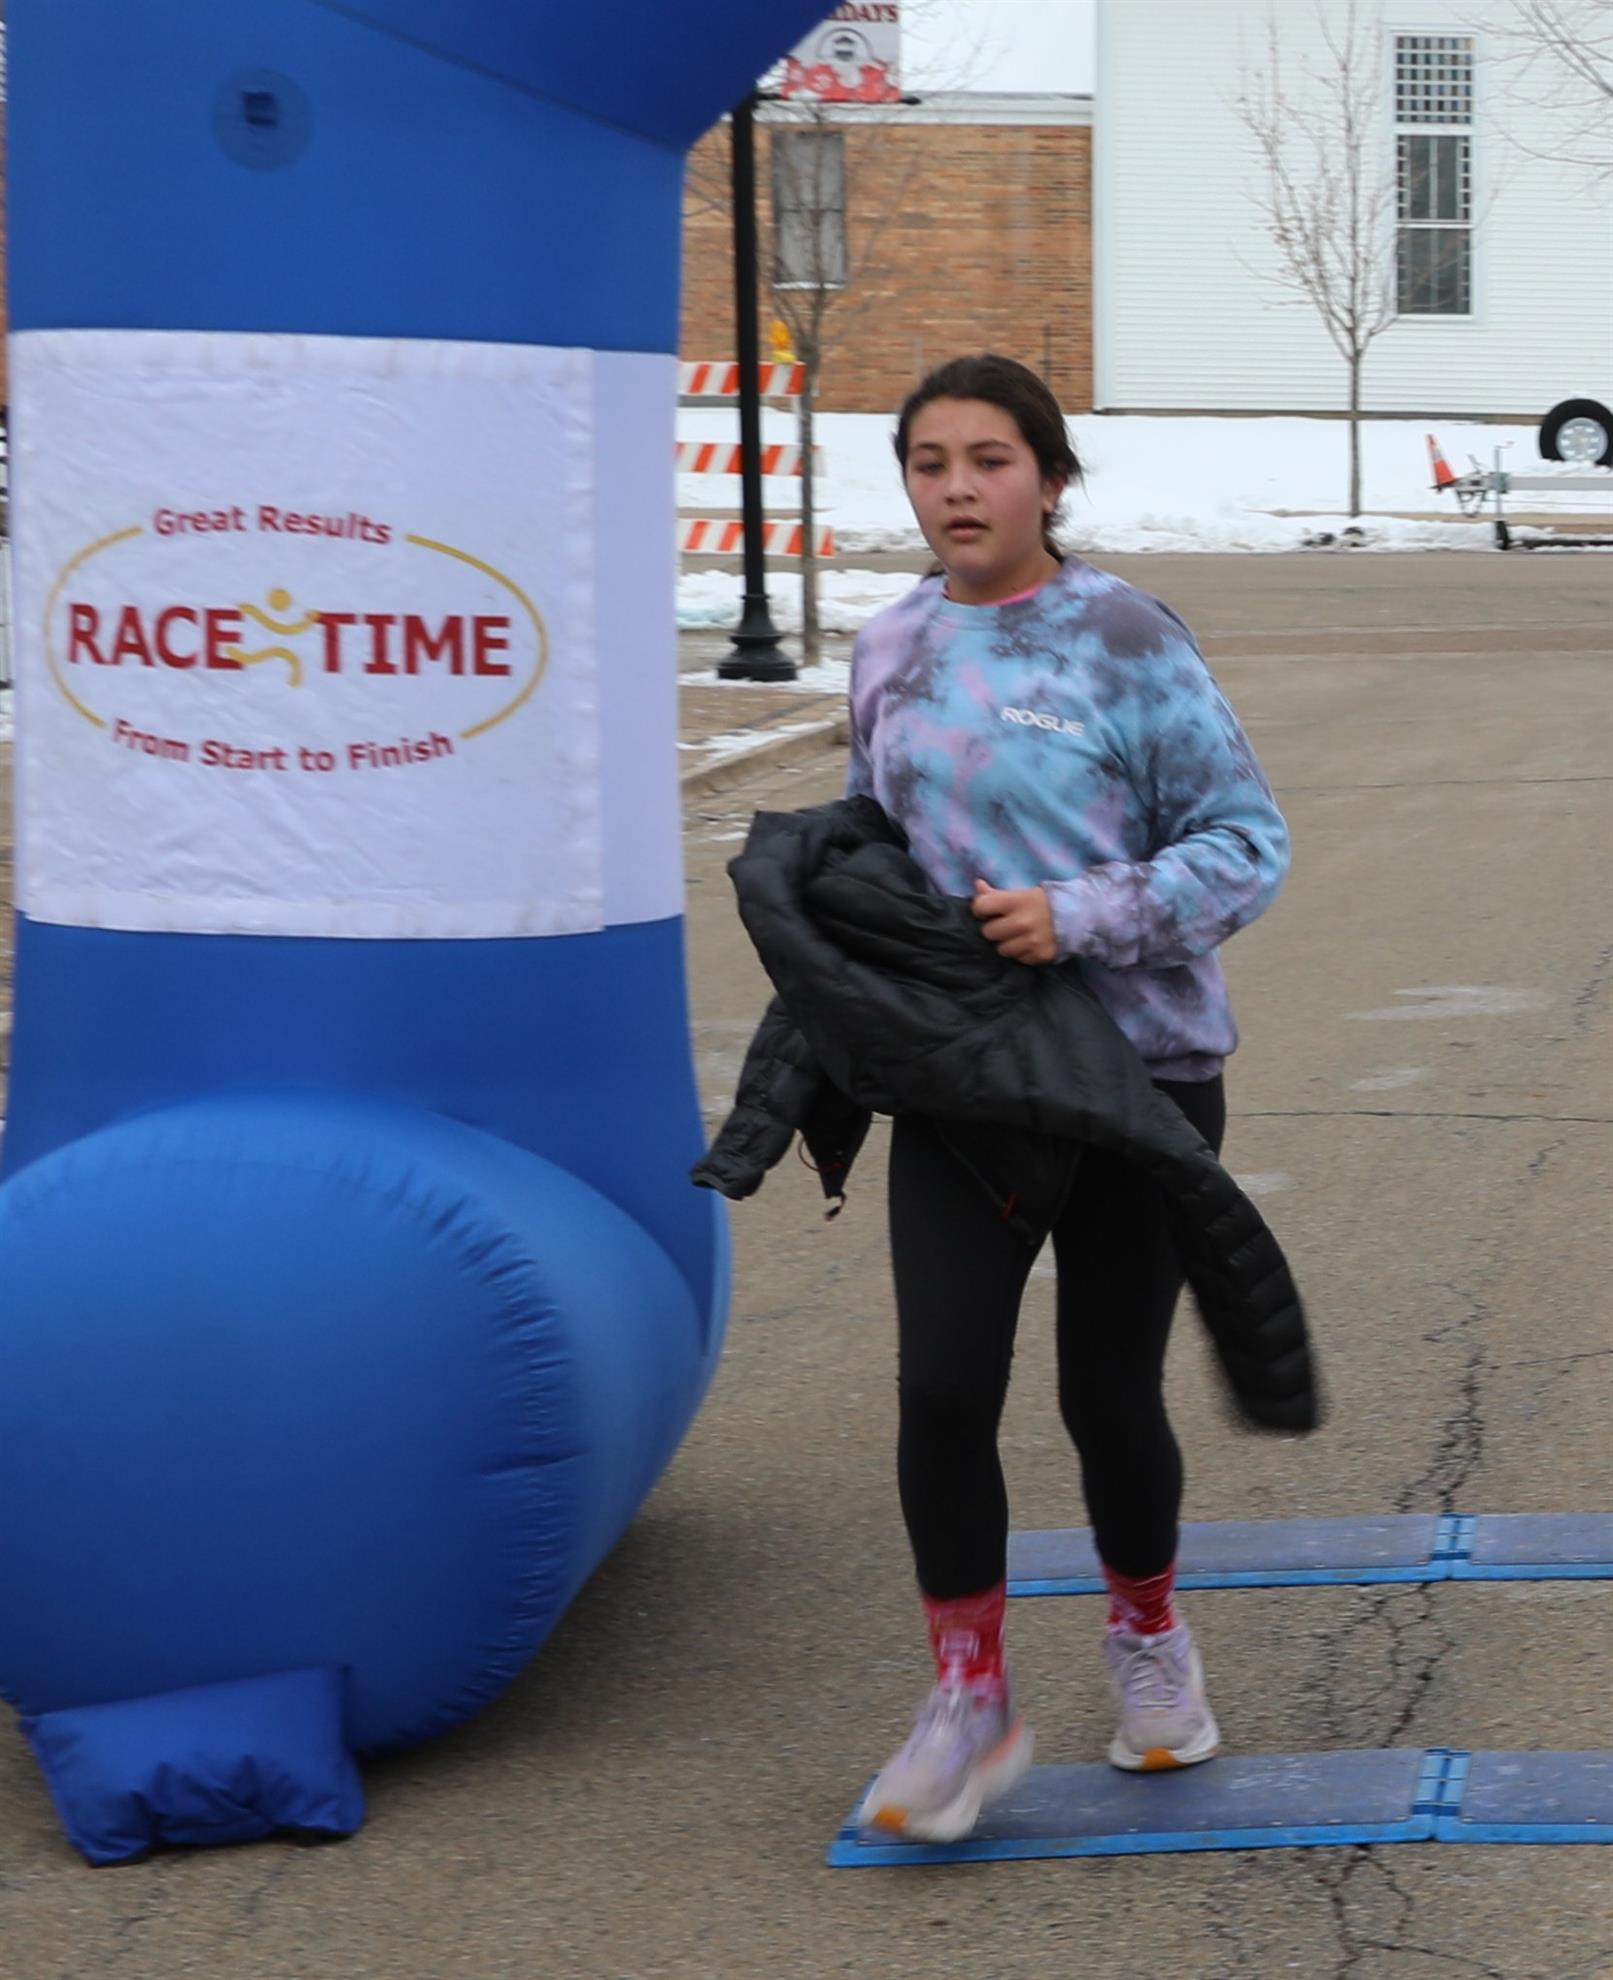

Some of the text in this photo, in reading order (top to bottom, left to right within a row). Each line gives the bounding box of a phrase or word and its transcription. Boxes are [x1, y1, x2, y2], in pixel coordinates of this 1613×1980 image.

[155, 505, 392, 544] Great Results
[68, 603, 511, 676] RACE TIME
[1001, 706, 1086, 737] ROGUE
[114, 718, 454, 772] From Start to Finish
